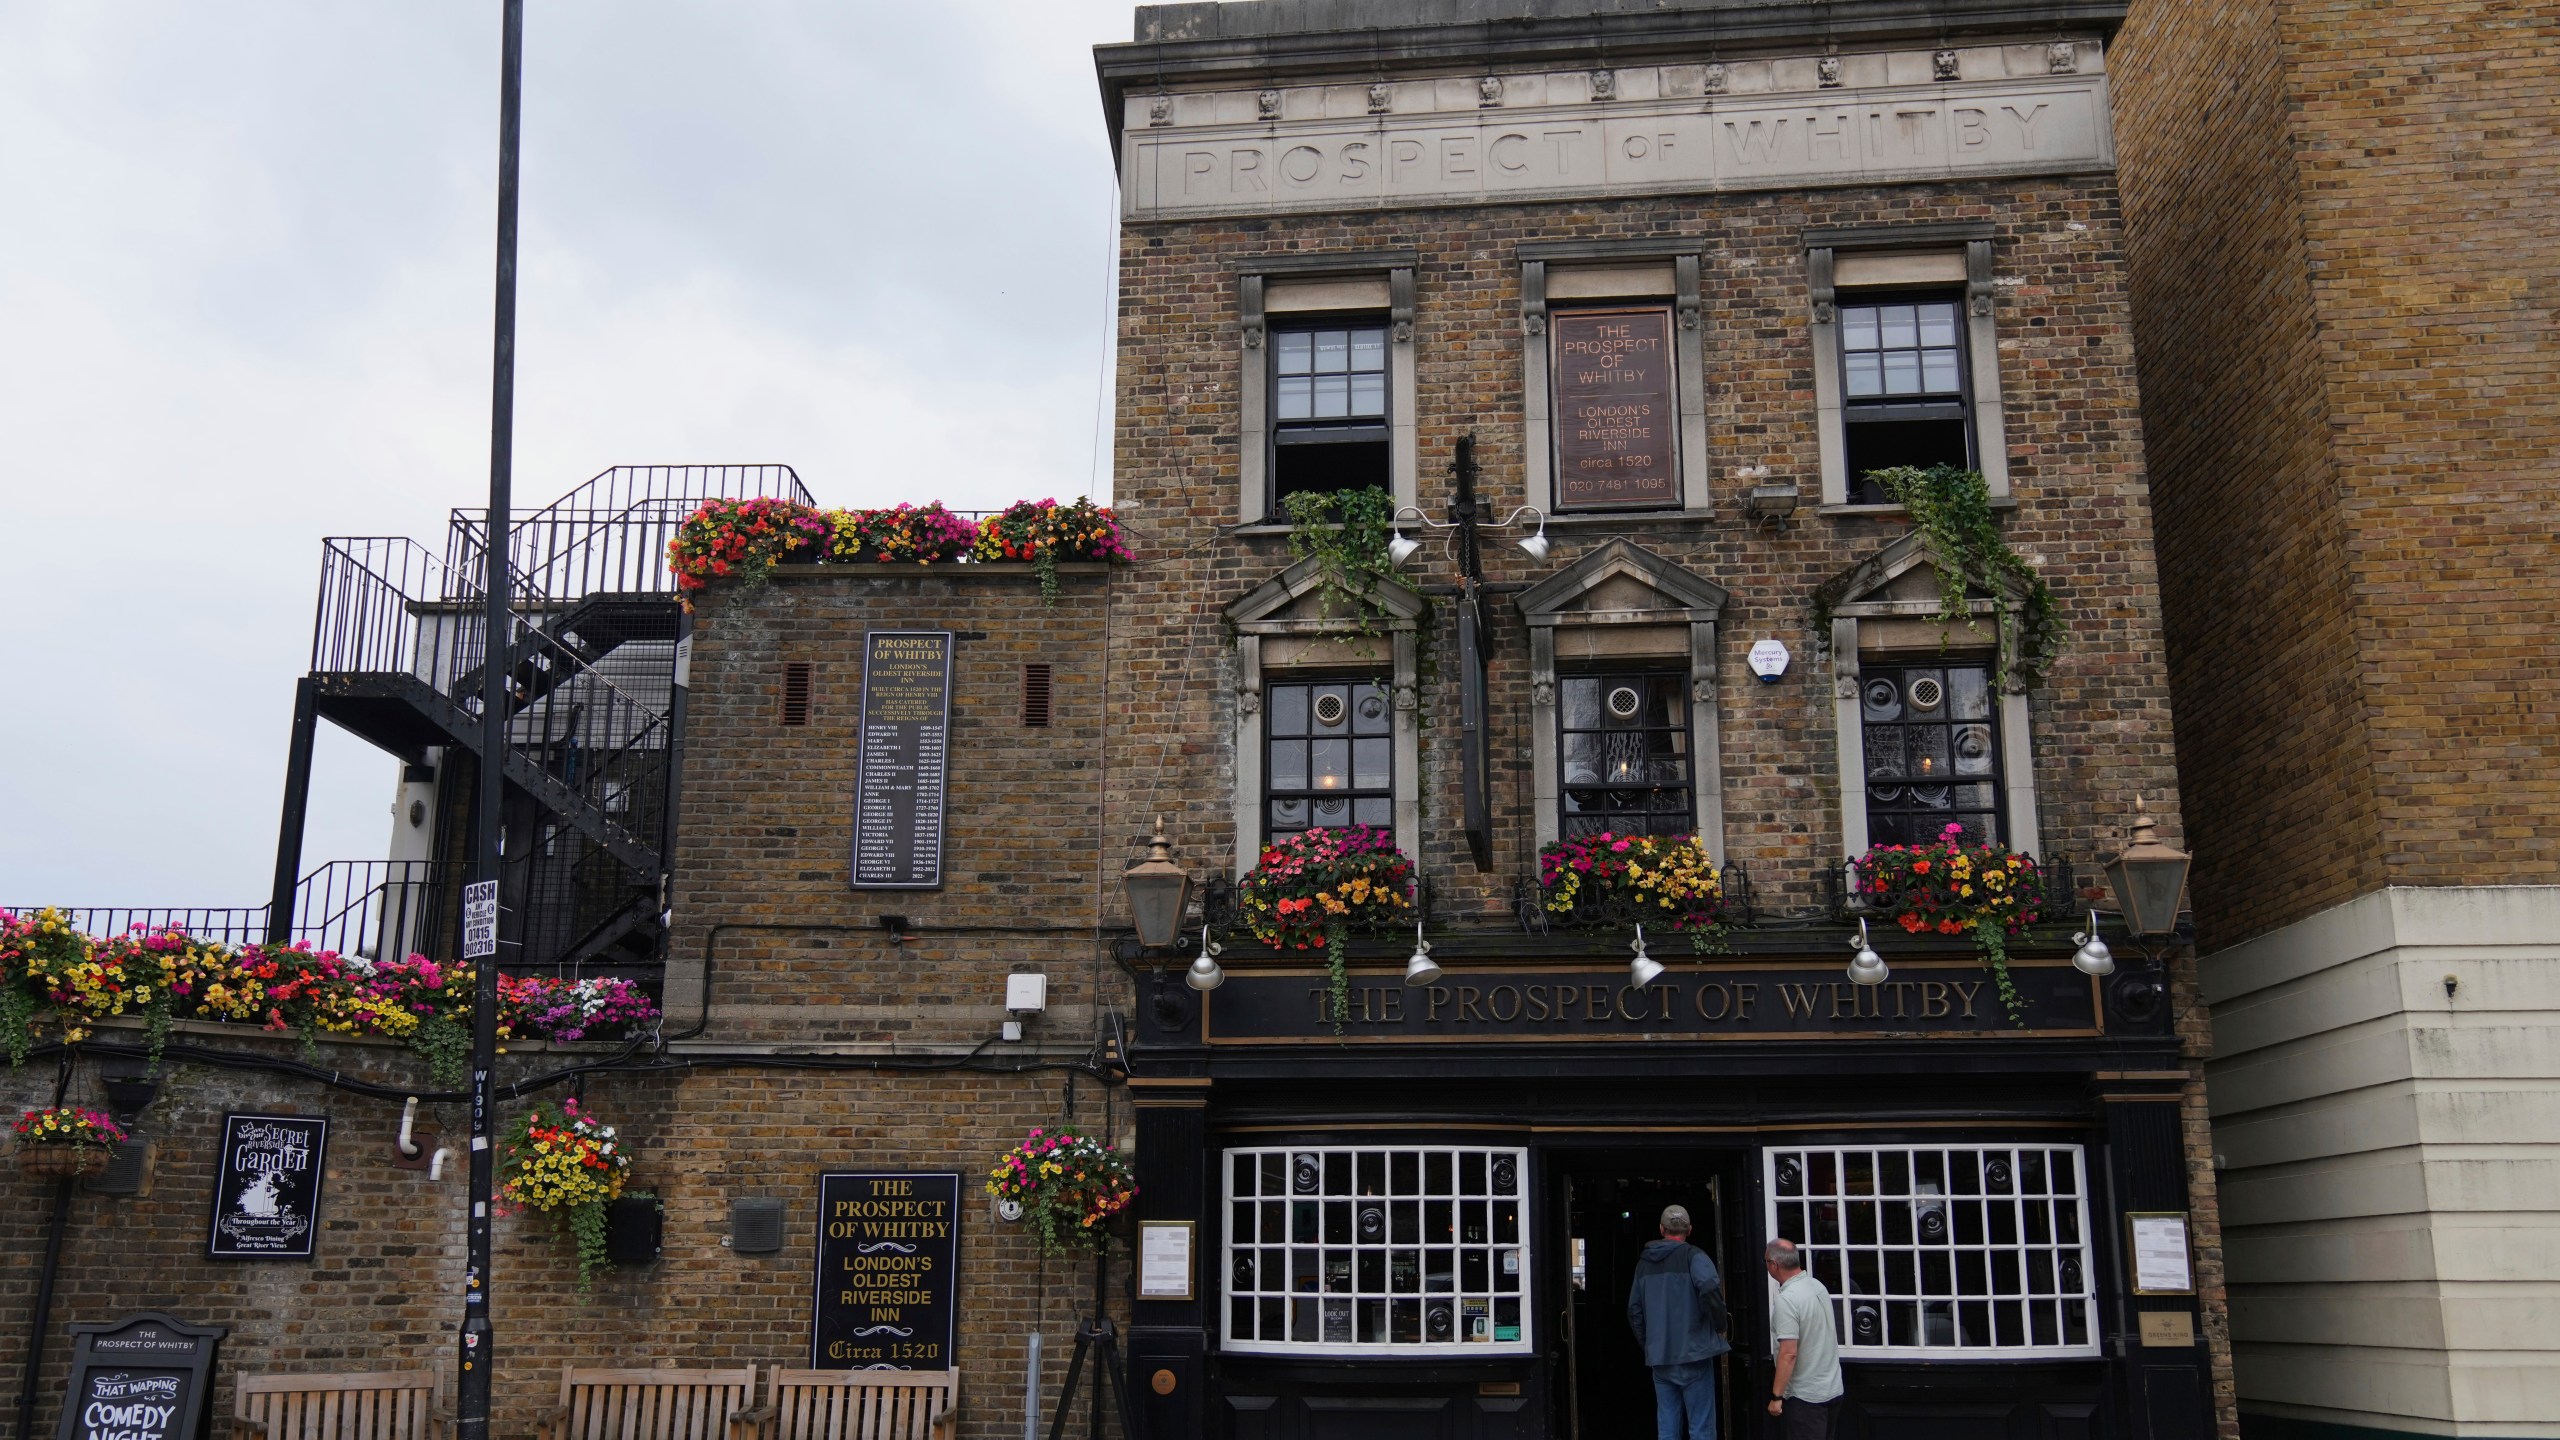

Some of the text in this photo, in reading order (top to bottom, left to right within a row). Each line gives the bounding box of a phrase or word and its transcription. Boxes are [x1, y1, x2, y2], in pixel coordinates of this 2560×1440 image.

[1184, 104, 2050, 195] PROSPECT OF WHITBY
[1597, 325, 1630, 338] THE
[1565, 339, 1658, 354] PROSPECT
[1600, 355, 1623, 368] OF
[1579, 369, 1646, 383] WHITBY
[1578, 405, 1650, 418] LONDON'S
[1588, 417, 1640, 428] OLDEST
[1579, 428, 1650, 439] RIVERSIDE
[1603, 440, 1627, 451] INN
[1580, 456, 1652, 468] circa 1520
[1570, 478, 1665, 491] 020 7481 1095
[878, 639, 942, 648] PROSPECT
[875, 651, 944, 659] OF WHITBY
[466, 883, 495, 904] CASH
[472, 910, 487, 919] VEHICLE
[473, 917, 494, 927] CONDITION
[469, 926, 489, 941] 07415
[466, 939, 493, 956] 902316
[1309, 980, 1986, 1025] THE PROSPECT OF WHITBY
[237, 1127, 265, 1139] Discover
[869, 1180, 913, 1196] THE
[835, 1201, 946, 1217] PROSPECT
[829, 1221, 950, 1238] OF WHITBY
[843, 1256, 932, 1271] LONDON'S
[853, 1274, 922, 1287] OLDEST
[841, 1291, 931, 1305] RIVERSIDE
[871, 1308, 900, 1321] INN
[829, 1339, 938, 1359] Circa 1520
[96, 1379, 177, 1396] THAT WAPPING
[85, 1402, 176, 1429] COMEDY
